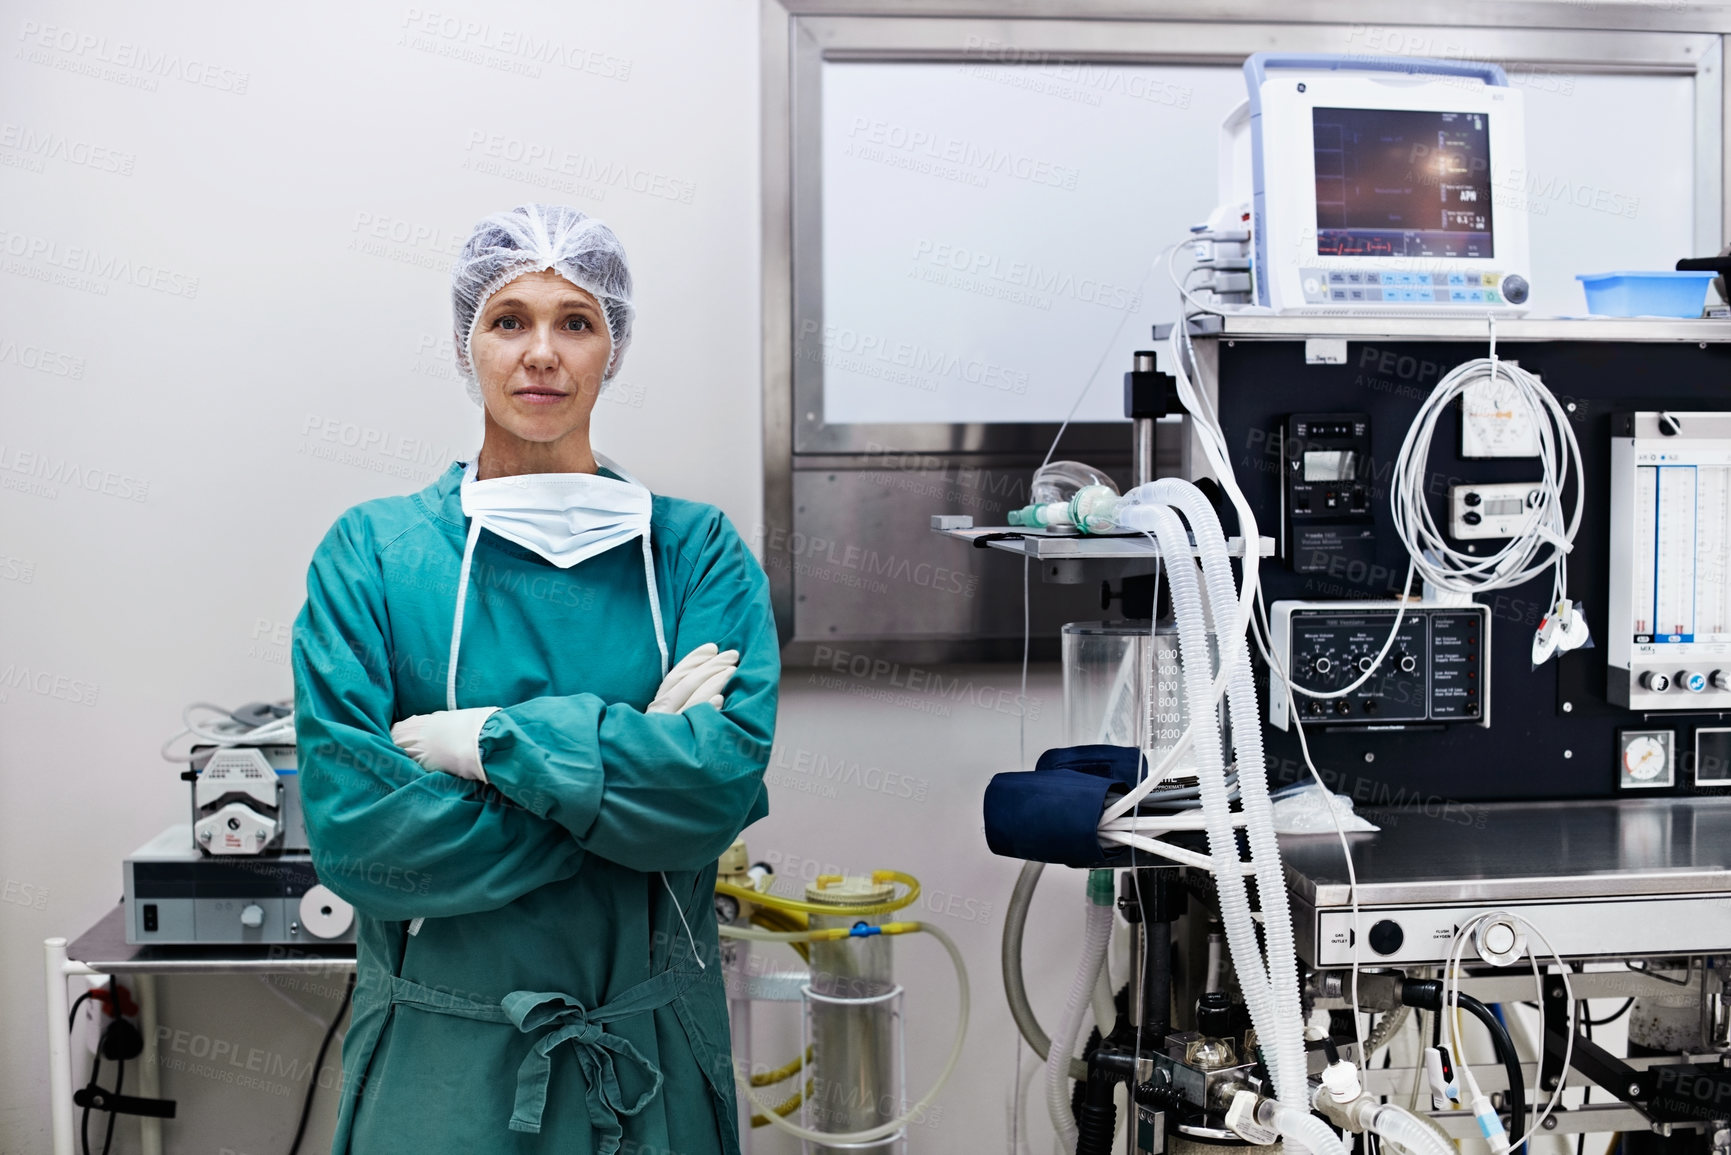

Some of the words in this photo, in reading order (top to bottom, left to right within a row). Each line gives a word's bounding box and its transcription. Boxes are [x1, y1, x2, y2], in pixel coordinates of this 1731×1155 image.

[1158, 649, 1178, 660] 200
[1158, 665, 1178, 675] 400
[1158, 681, 1178, 691] 600
[1158, 697, 1178, 707] 800
[1156, 713, 1180, 723] 1000
[1156, 729, 1180, 739] 1200
[1156, 745, 1174, 754] 140
